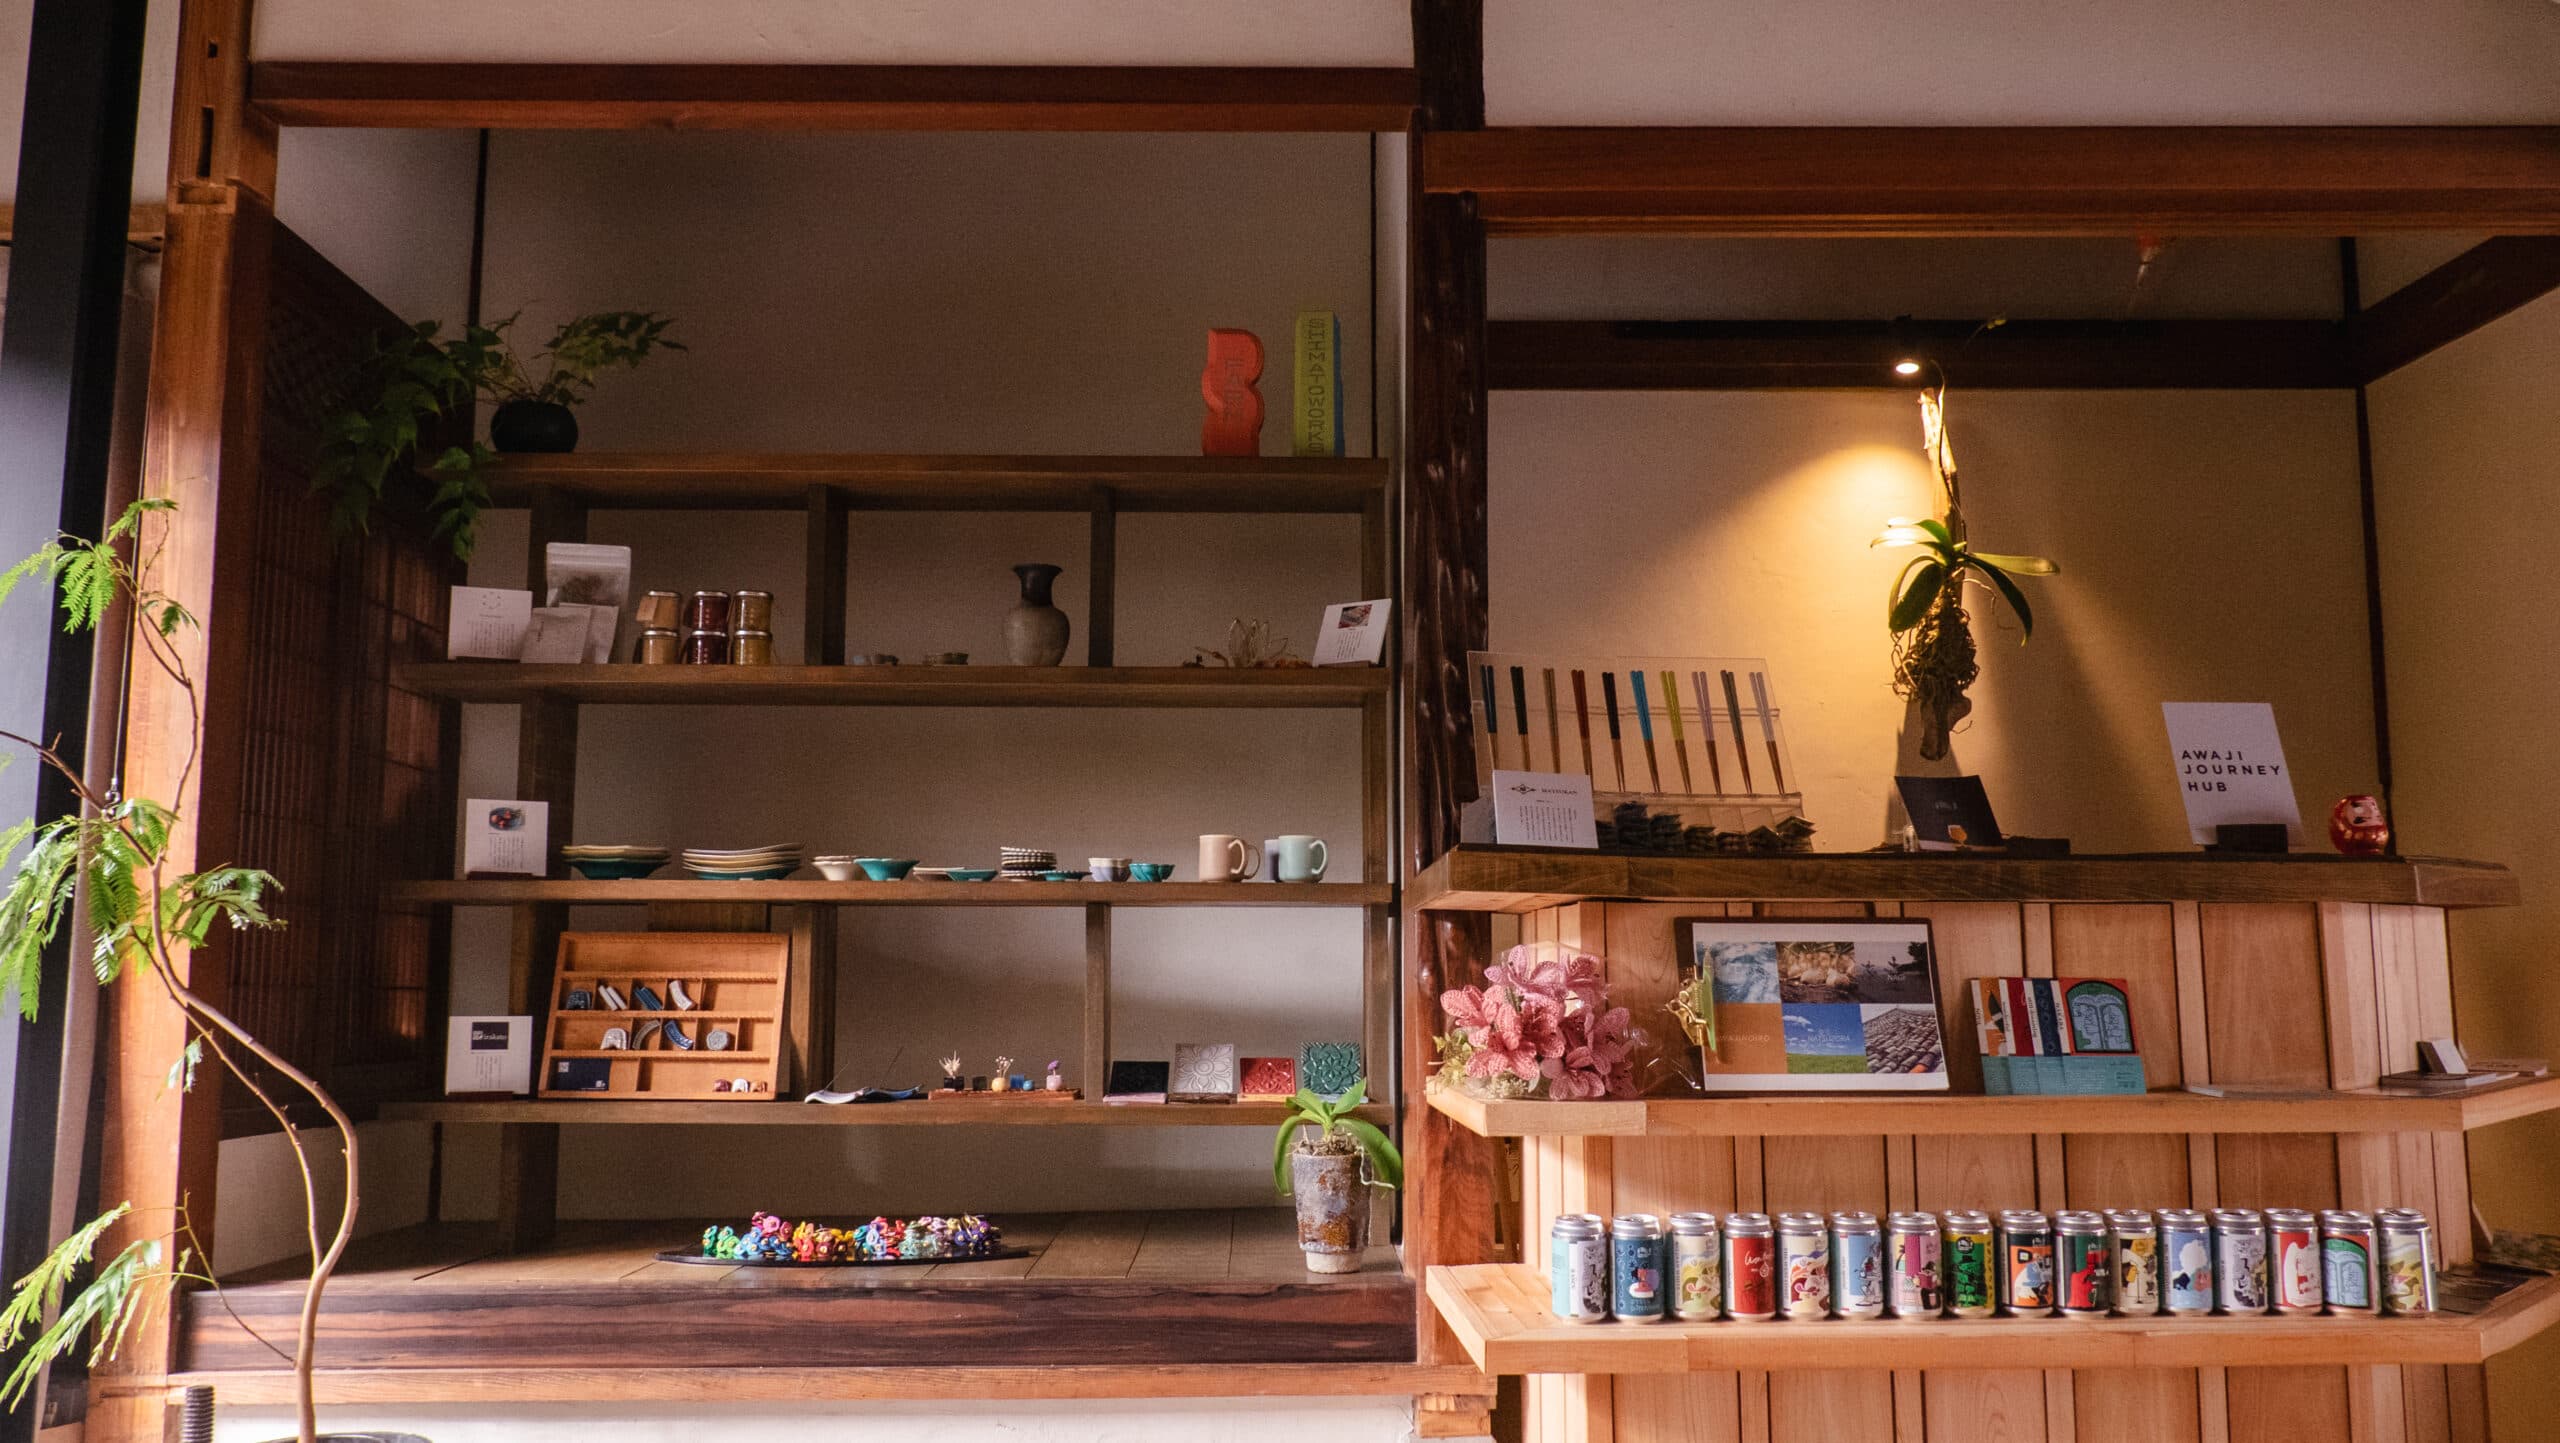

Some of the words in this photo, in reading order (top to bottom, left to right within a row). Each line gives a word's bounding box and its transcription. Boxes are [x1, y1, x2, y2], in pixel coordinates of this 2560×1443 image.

[1308, 318, 1326, 454] SHIMATOWORKS
[2182, 750, 2242, 760] AWAJI
[2184, 764, 2280, 775] JOURNEY
[2188, 782, 2227, 792] HUB
